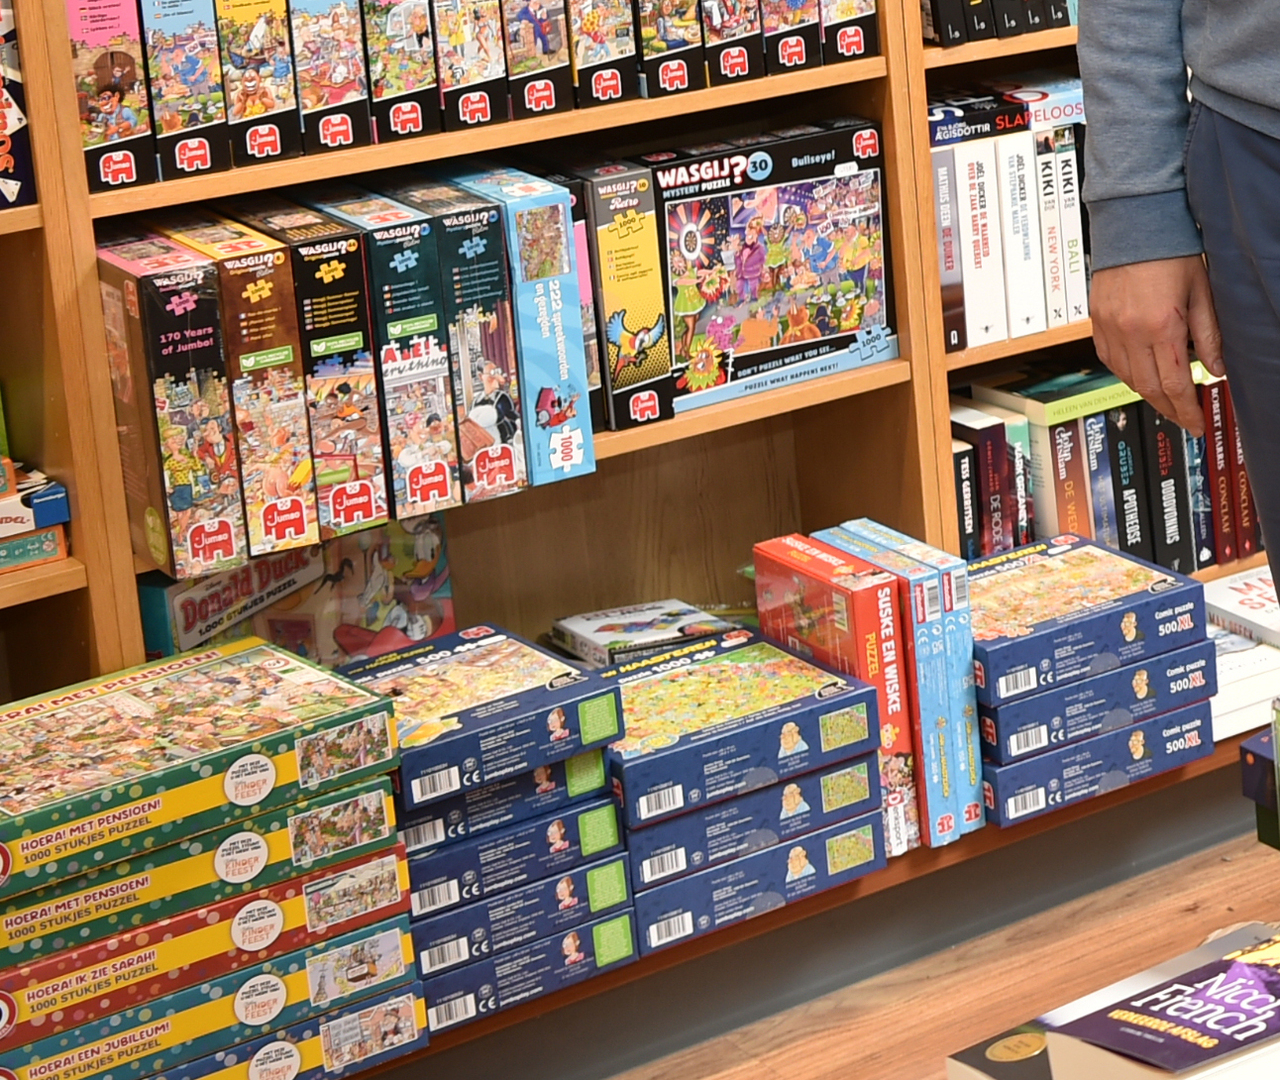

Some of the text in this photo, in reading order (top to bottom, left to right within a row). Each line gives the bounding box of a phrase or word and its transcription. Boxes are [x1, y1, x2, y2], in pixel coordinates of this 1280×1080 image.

[995, 103, 1083, 130] SLAPELOOS
[657, 155, 767, 188] WASGIJ? 30
[791, 150, 835, 167] Bullseye!
[1041, 161, 1054, 198] KIKI
[663, 179, 730, 198] MYSTERY PUZZLE
[1067, 240, 1080, 274] BALI
[534, 283, 549, 338] en gezegden
[548, 280, 568, 380] 222 spreekwoorden
[160, 326, 213, 343] 170 Years
[162, 338, 213, 354] of Jumbo!
[558, 435, 572, 471] 1000
[1211, 388, 1230, 534] ROBERT HARRIS CONCLAAF
[1123, 489, 1140, 546] APOTHEOSE
[867, 631, 878, 679] PUZZEL
[876, 588, 902, 715] SUSKE EN WISKE
[20, 799, 161, 853] HOERA! MET PENSIOEN!
[24, 817, 152, 864] 1000 STUKJES PUZZEL
[27, 950, 156, 1003] HOERA! IK ZIE SARAH!
[1131, 983, 1274, 1043] French
